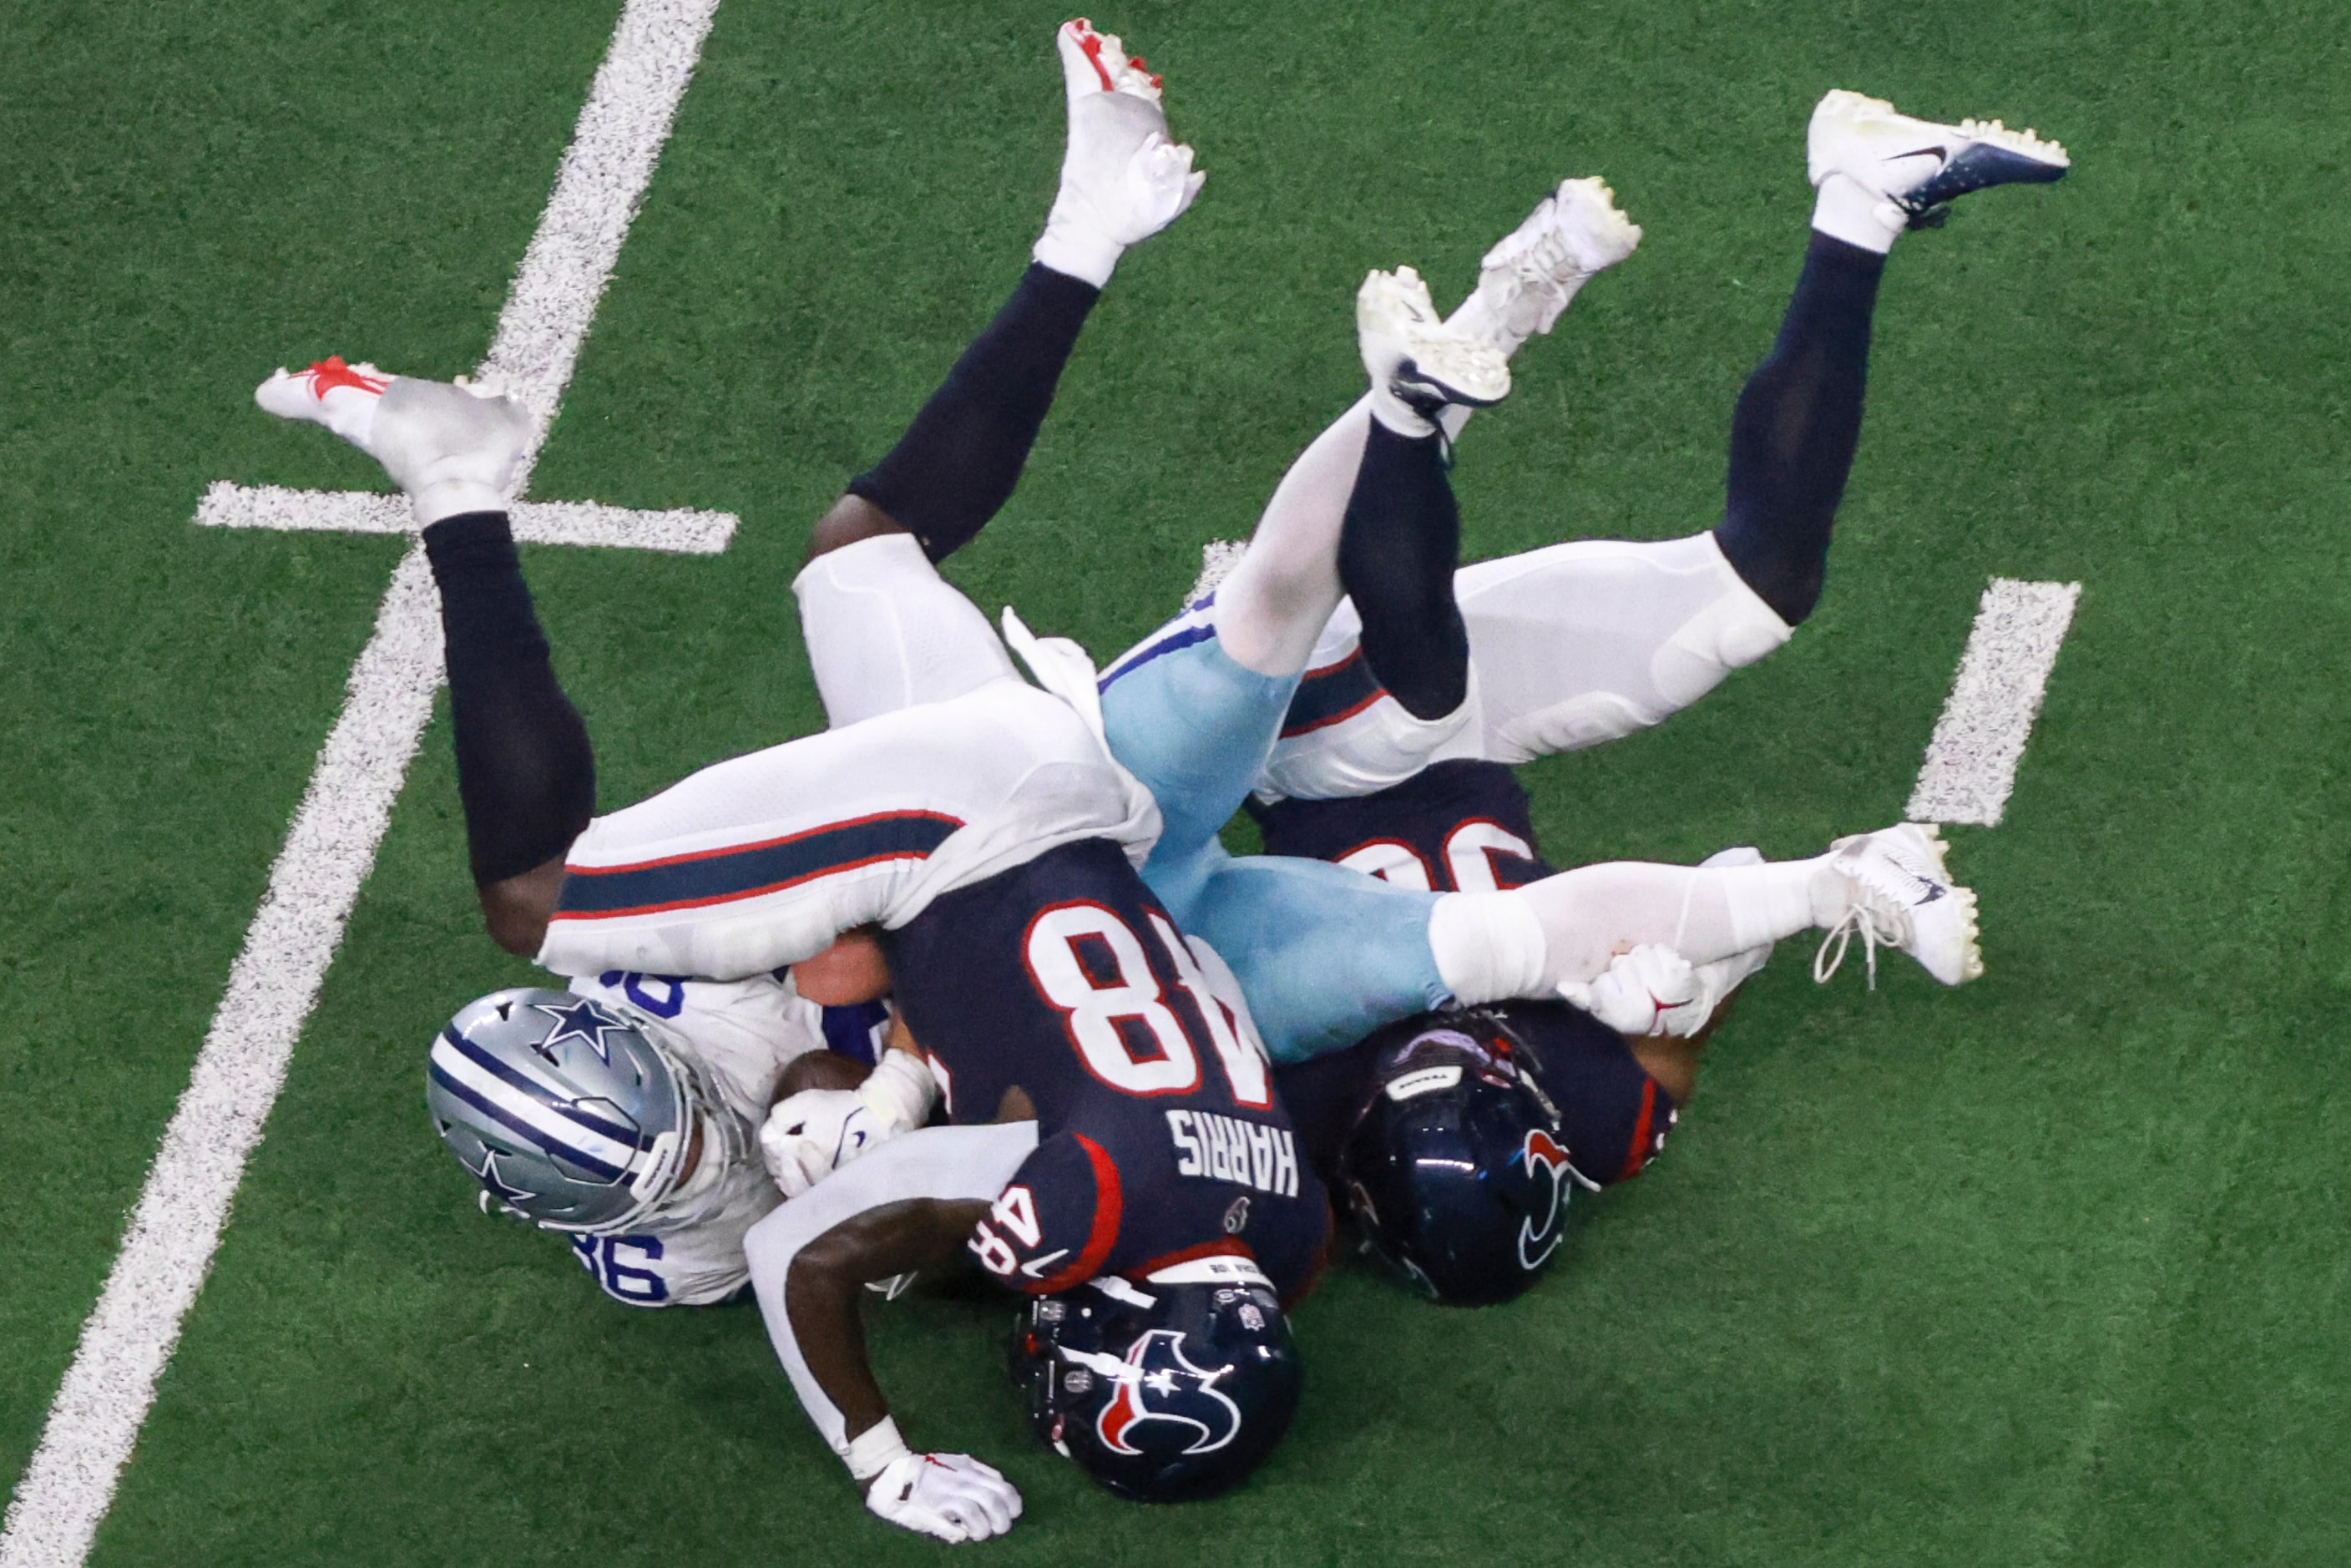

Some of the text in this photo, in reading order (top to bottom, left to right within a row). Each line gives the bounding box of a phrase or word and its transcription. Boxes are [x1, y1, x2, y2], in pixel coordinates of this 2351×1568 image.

[1022, 898, 1272, 1109] 48
[1165, 1109, 1299, 1197] HARRIS
[968, 1184, 1042, 1275] 48
